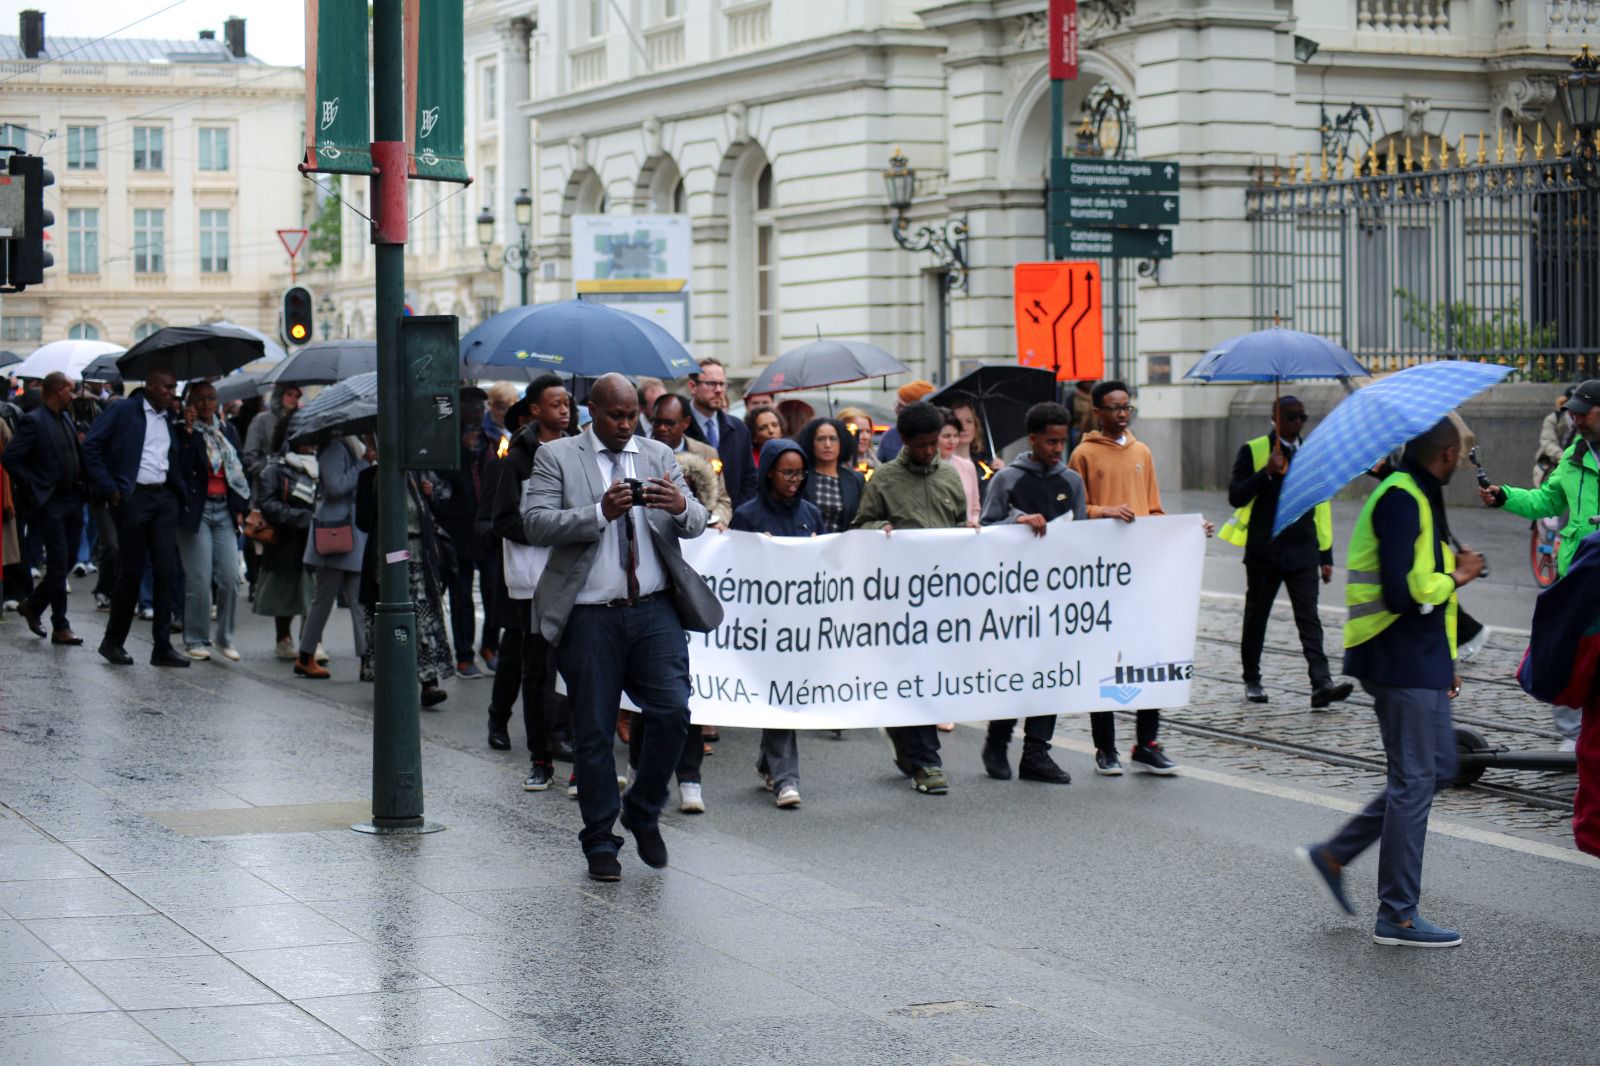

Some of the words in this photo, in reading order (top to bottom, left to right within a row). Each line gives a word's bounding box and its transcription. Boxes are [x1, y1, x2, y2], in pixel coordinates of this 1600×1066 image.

[863, 567, 900, 601] du
[908, 561, 1039, 607] génocide
[1046, 556, 1132, 591] contre
[776, 627, 811, 652] au
[818, 612, 928, 651] Rwanda
[936, 618, 971, 643] en
[979, 605, 1040, 642] Avril
[1049, 600, 1112, 637] 1994
[768, 677, 888, 706] Mémoire
[897, 675, 924, 698] et
[931, 669, 1024, 697] Justice
[1031, 660, 1081, 689] asbl
